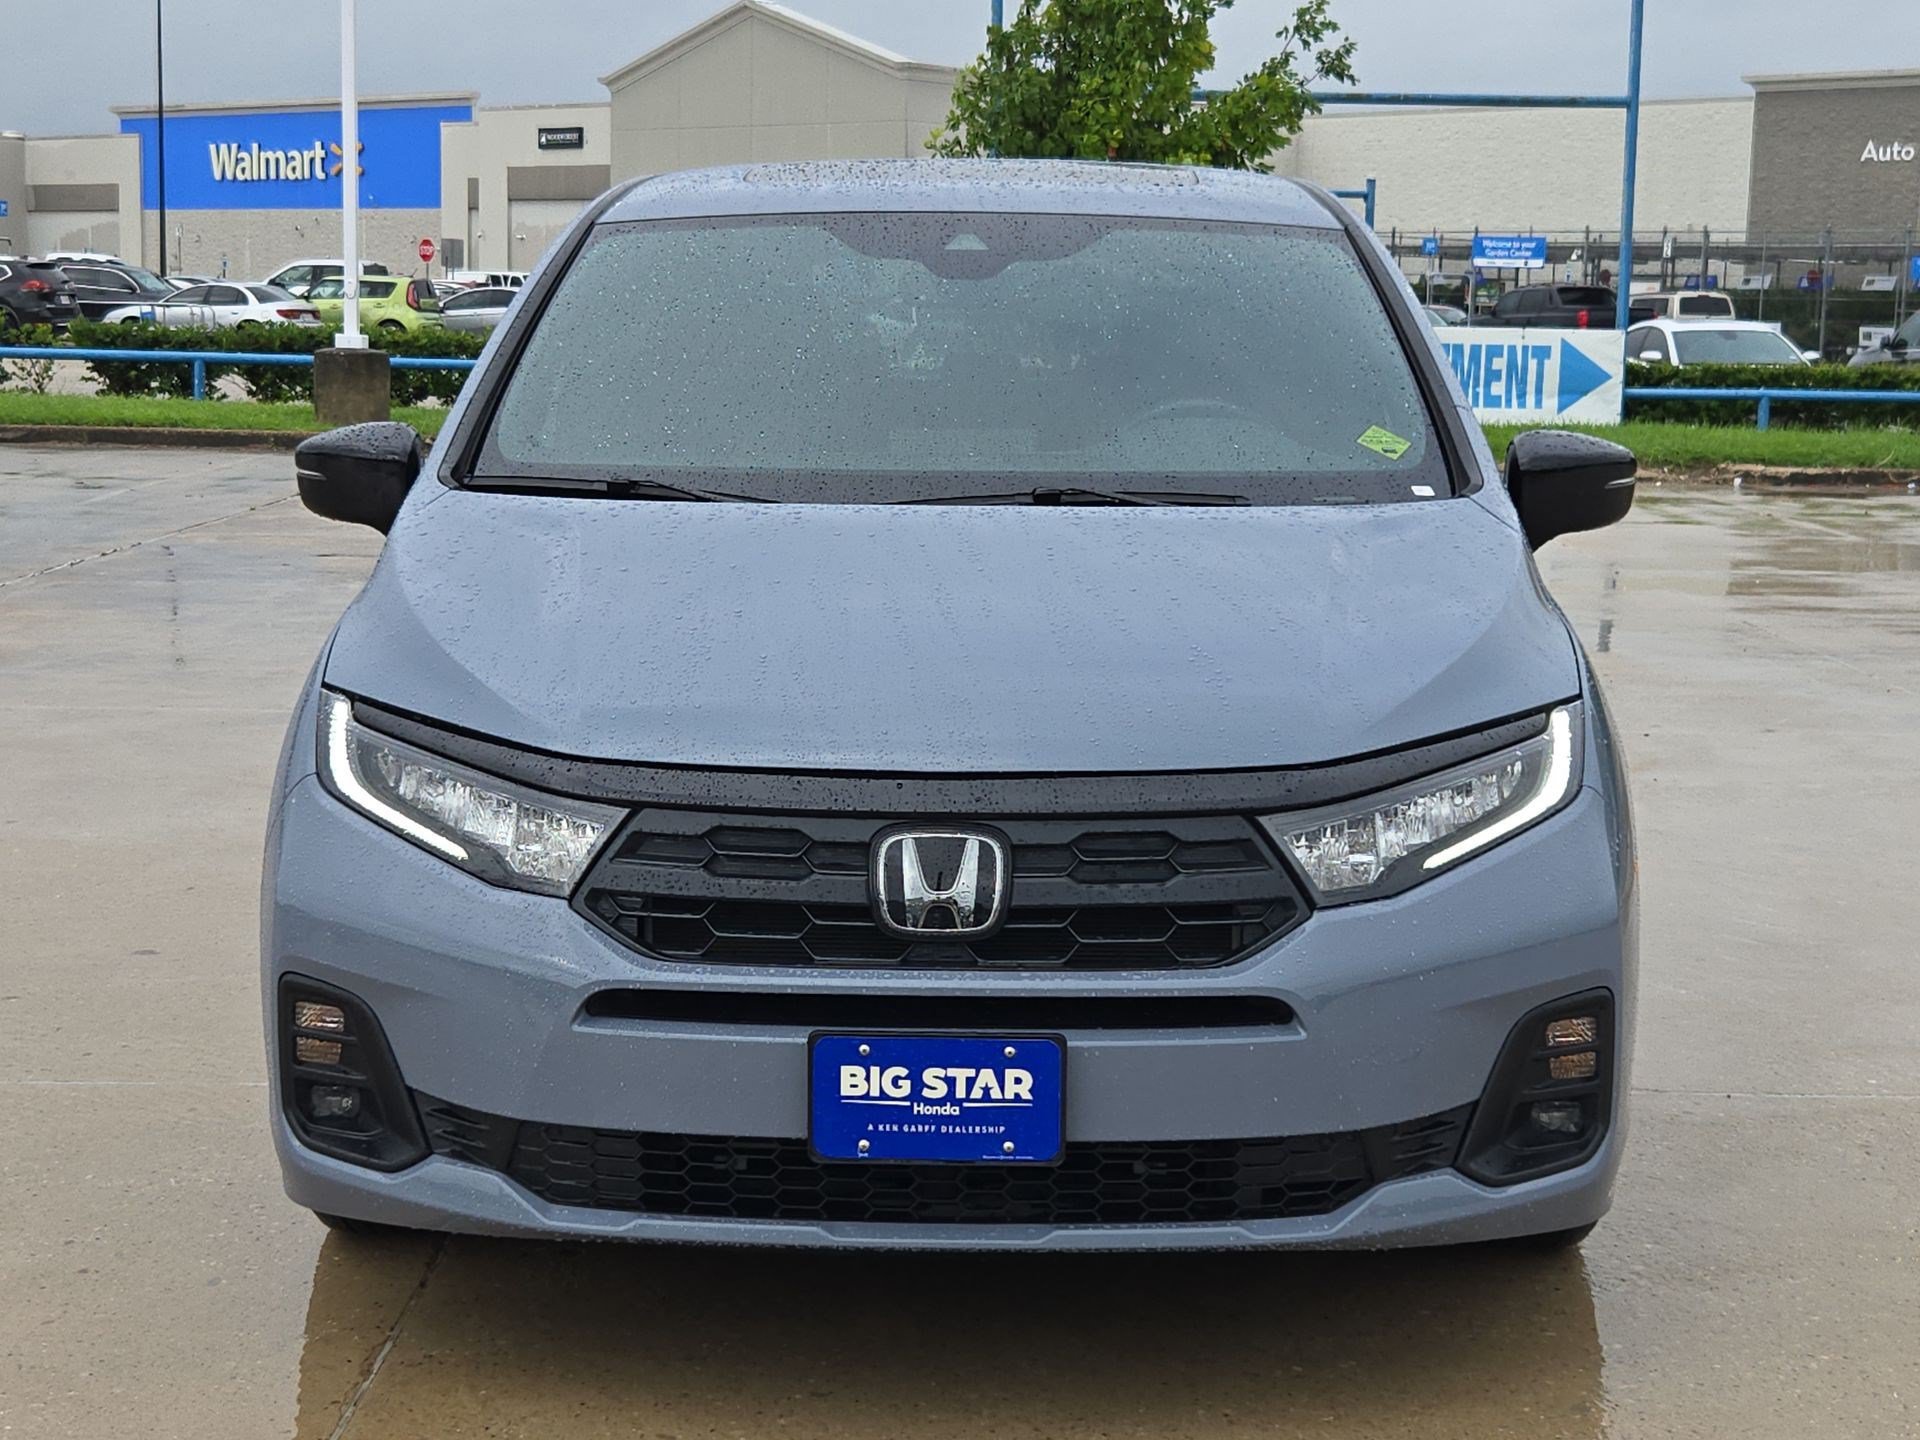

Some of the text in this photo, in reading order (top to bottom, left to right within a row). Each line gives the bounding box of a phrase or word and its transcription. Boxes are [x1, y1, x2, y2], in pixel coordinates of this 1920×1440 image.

[1860, 139, 1915, 162] Auto
[209, 140, 326, 181] Walmart
[1482, 240, 1511, 249] Welcome
[1521, 241, 1536, 251] your
[1485, 249, 1532, 257] Garden Center
[1442, 343, 1552, 409] MENT
[840, 1065, 1034, 1100] BIG STAR
[913, 1102, 960, 1116] Honda
[878, 1124, 899, 1132] KEN
[902, 1124, 936, 1133] GARFF
[940, 1125, 1006, 1134] DEALERSHIP
